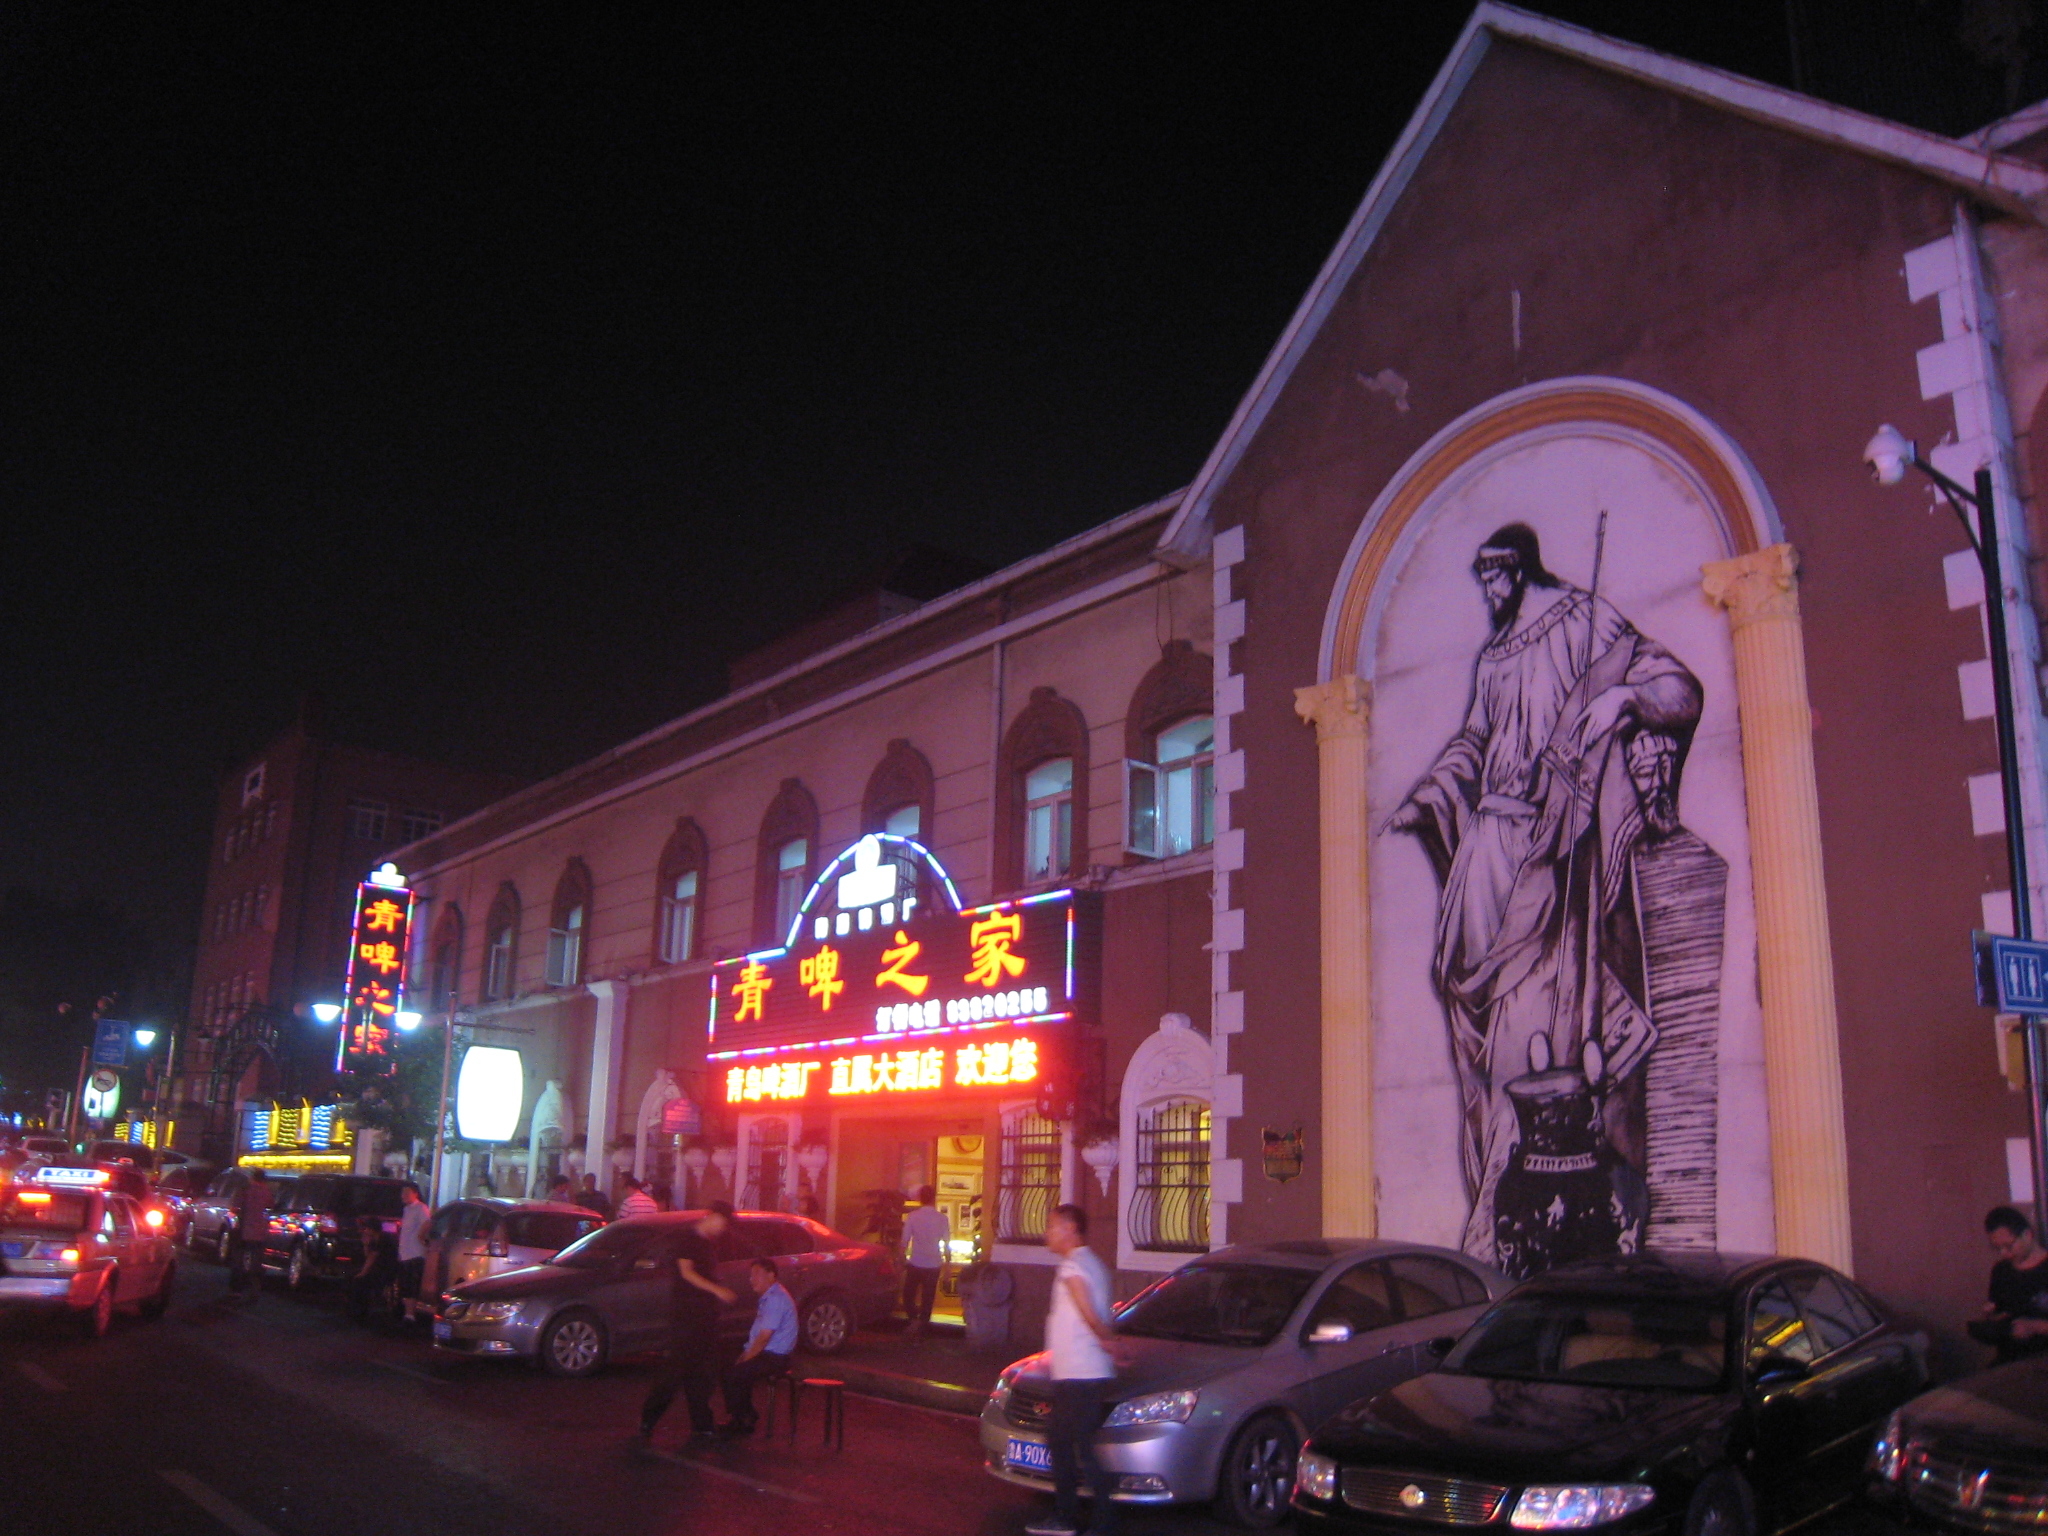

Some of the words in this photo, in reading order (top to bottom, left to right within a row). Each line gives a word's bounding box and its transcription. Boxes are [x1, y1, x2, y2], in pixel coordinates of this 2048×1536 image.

[730, 909, 1027, 1023] 青啤之家
[828, 1046, 946, 1096] 直属大酒店
[954, 1037, 1039, 1087] 欢迎您
